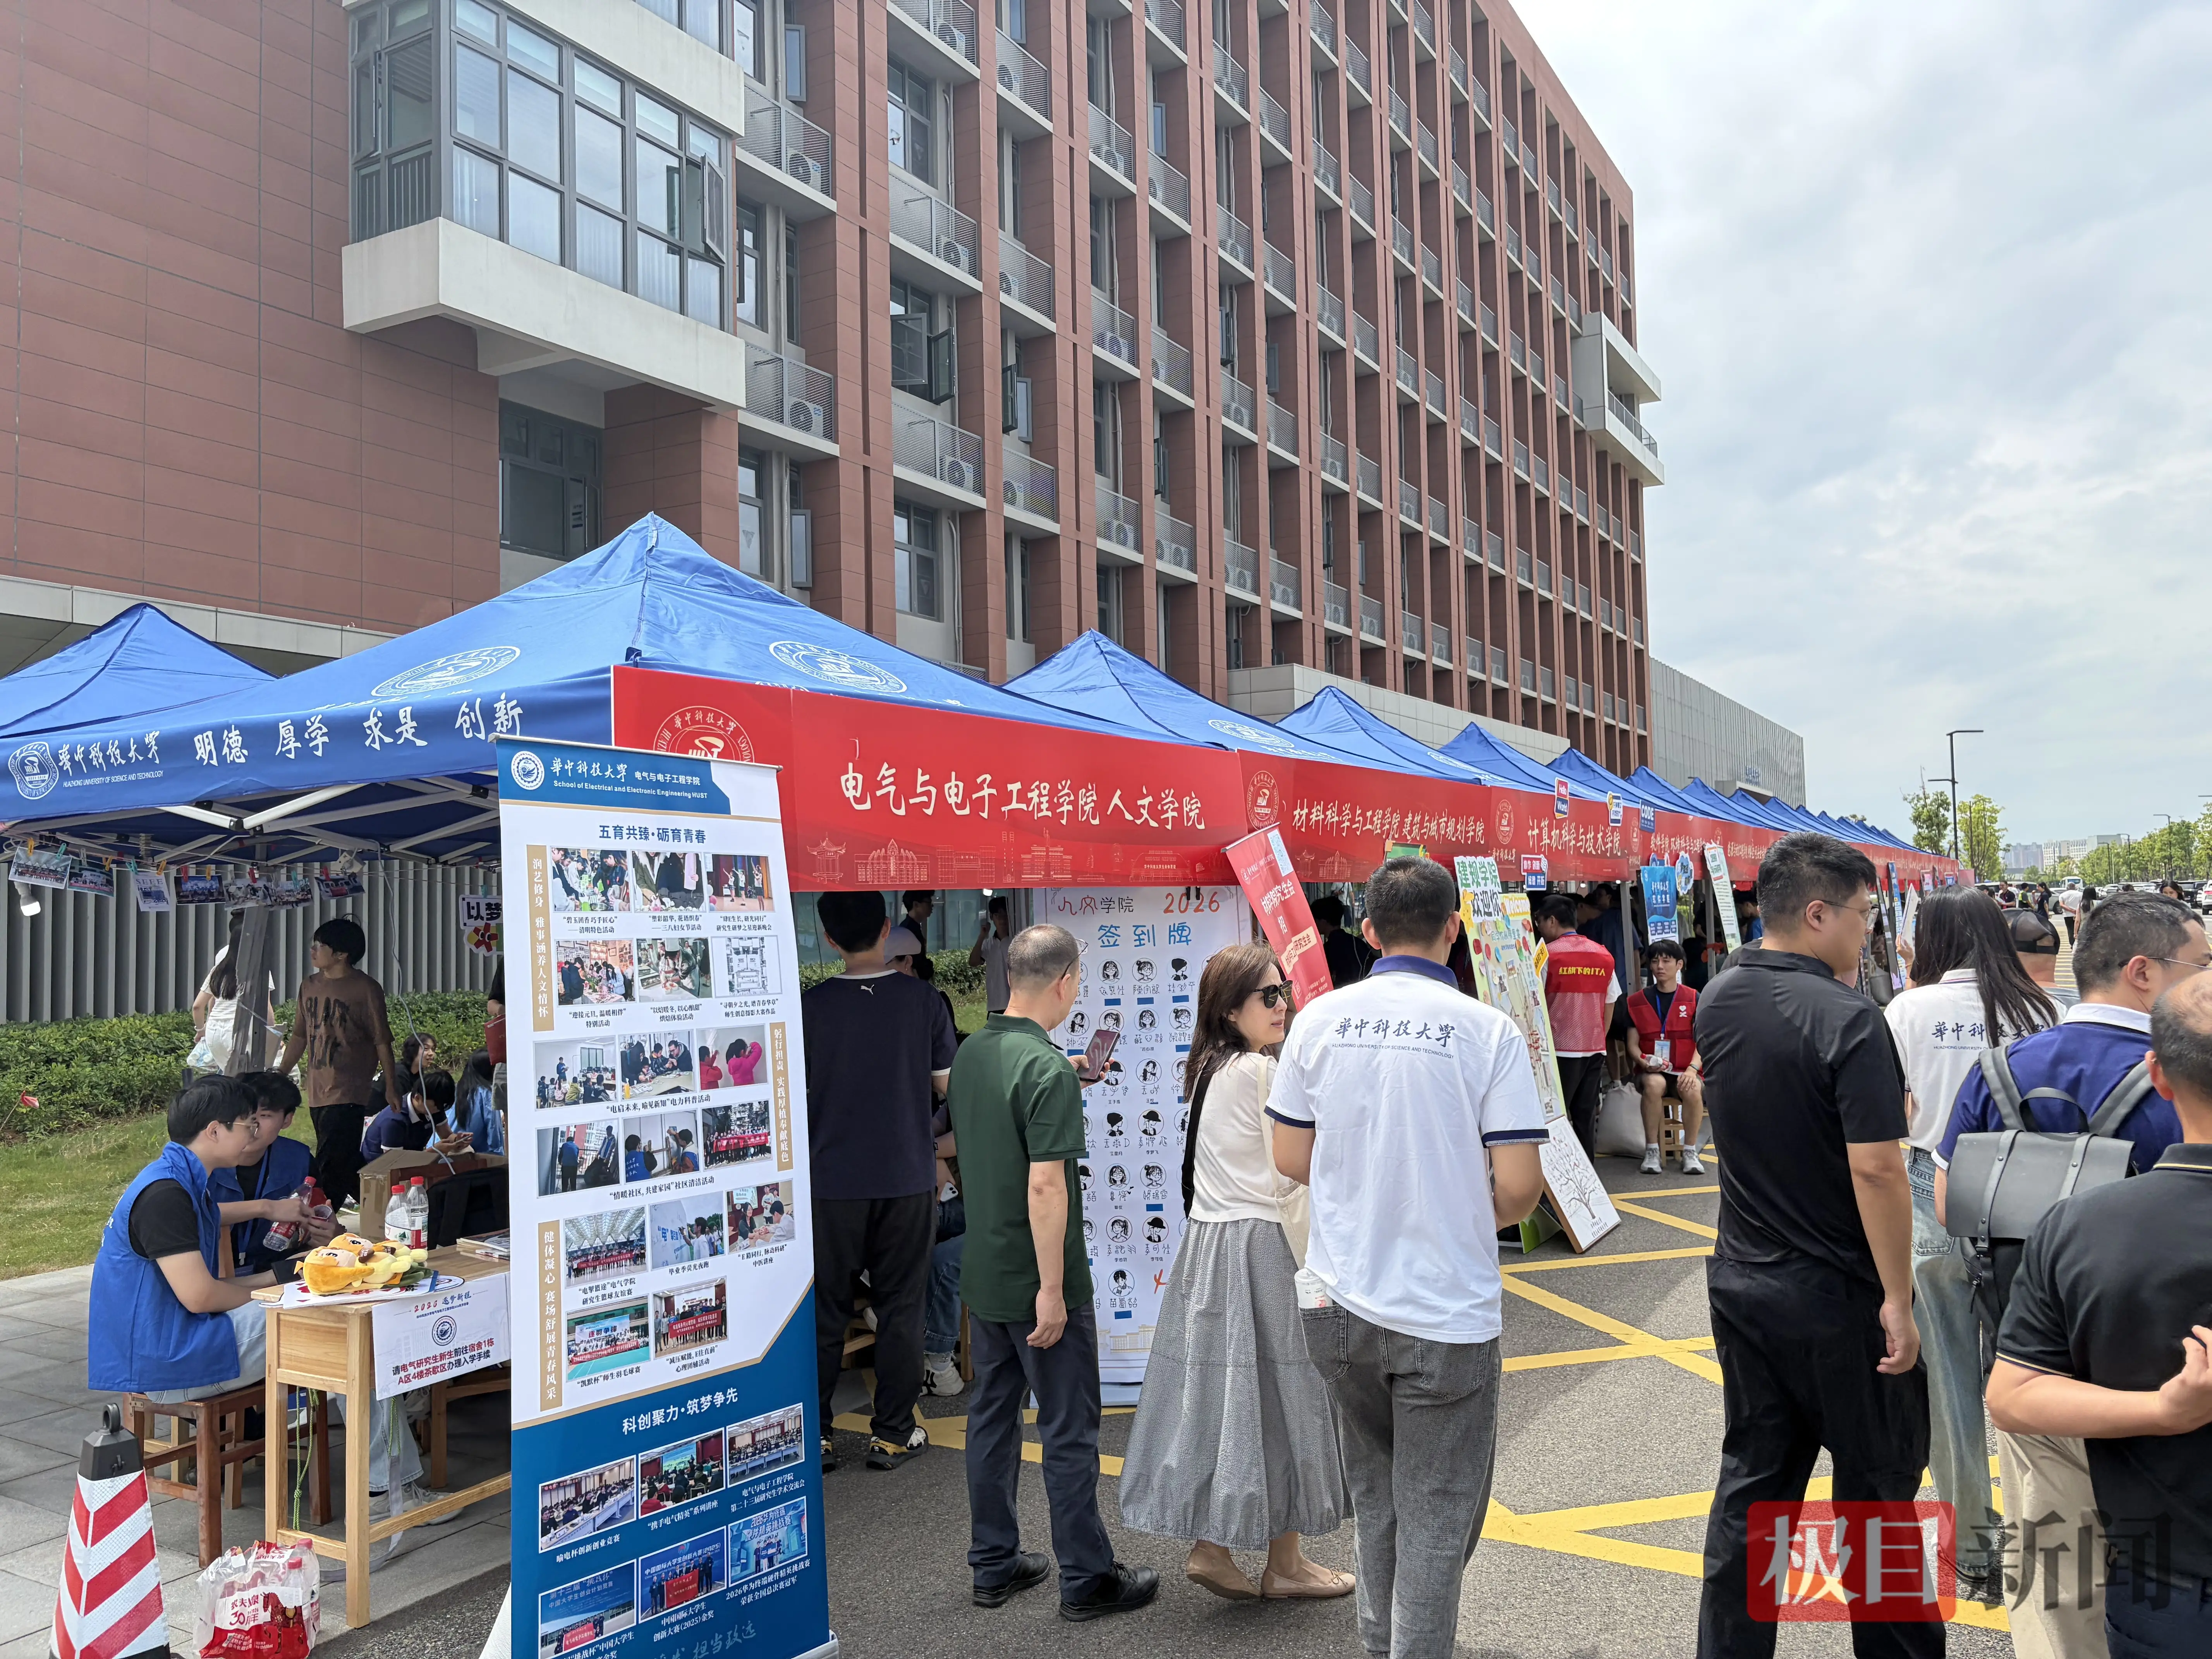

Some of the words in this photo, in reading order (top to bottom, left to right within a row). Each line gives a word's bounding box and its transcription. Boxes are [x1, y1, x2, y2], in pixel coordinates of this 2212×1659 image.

[194, 724, 248, 767] 明德
[275, 714, 330, 759] 厚学
[362, 706, 428, 751] 求是
[455, 692, 524, 739] 创新
[137, 770, 163, 780] TECHNOLOGY
[634, 771, 701, 786] 电气与电子工程学院
[553, 780, 576, 789] School
[577, 781, 584, 789] of
[585, 782, 613, 792] Electrical
[627, 786, 656, 795] Electronic
[657, 788, 691, 799] Engineering
[840, 762, 1100, 826] 电气与电子工程学院
[1106, 785, 1206, 831] 人文学院
[1559, 783, 1567, 796] Hello
[1557, 800, 1568, 813] World
[1641, 804, 1654, 821] CODE
[1292, 798, 1400, 840] 材料科学与工程学院
[1401, 809, 1485, 845] 建筑与城市规划学院
[1527, 815, 1621, 857] 计算机科学与技术学院
[532, 858, 544, 908] 润艺修身
[1456, 859, 1501, 889] 建规学院
[466, 901, 501, 921] 以梦
[1163, 891, 1221, 914] 2026
[1097, 922, 1192, 948] 签到牌
[535, 917, 548, 1018] 雅事涵养人文情怀
[1558, 967, 1606, 977] 红旗下的IT人
[586, 1020, 610, 1028] 特别活动
[659, 1013, 694, 1022] 烘焙体验活动
[1422, 1048, 1454, 1059] TECHNOLOGY
[543, 1231, 556, 1284] 健体凝心
[668, 1261, 709, 1276] 毕业季荧光夜跑
[753, 1257, 774, 1267] 中医讲座
[414, 1300, 438, 1313] 2026
[392, 1337, 495, 1376] 请电气研究生新生前往宿舍1栋
[545, 1290, 557, 1400] 赛场舒展青春风采
[398, 1349, 491, 1385] A区4楼茶歇区办理入学手续
[730, 1479, 805, 1513] 第二十三届研究生学术交流会
[742, 1472, 795, 1497] 电气与电子工程学院
[726, 1558, 811, 1601] 2026华为终端硬件精英挑战赛
[740, 1575, 797, 1607] 荣获全国总决赛冠军
[229, 1610, 246, 1626] 30
[661, 1601, 706, 1627] 中国国际大学生
